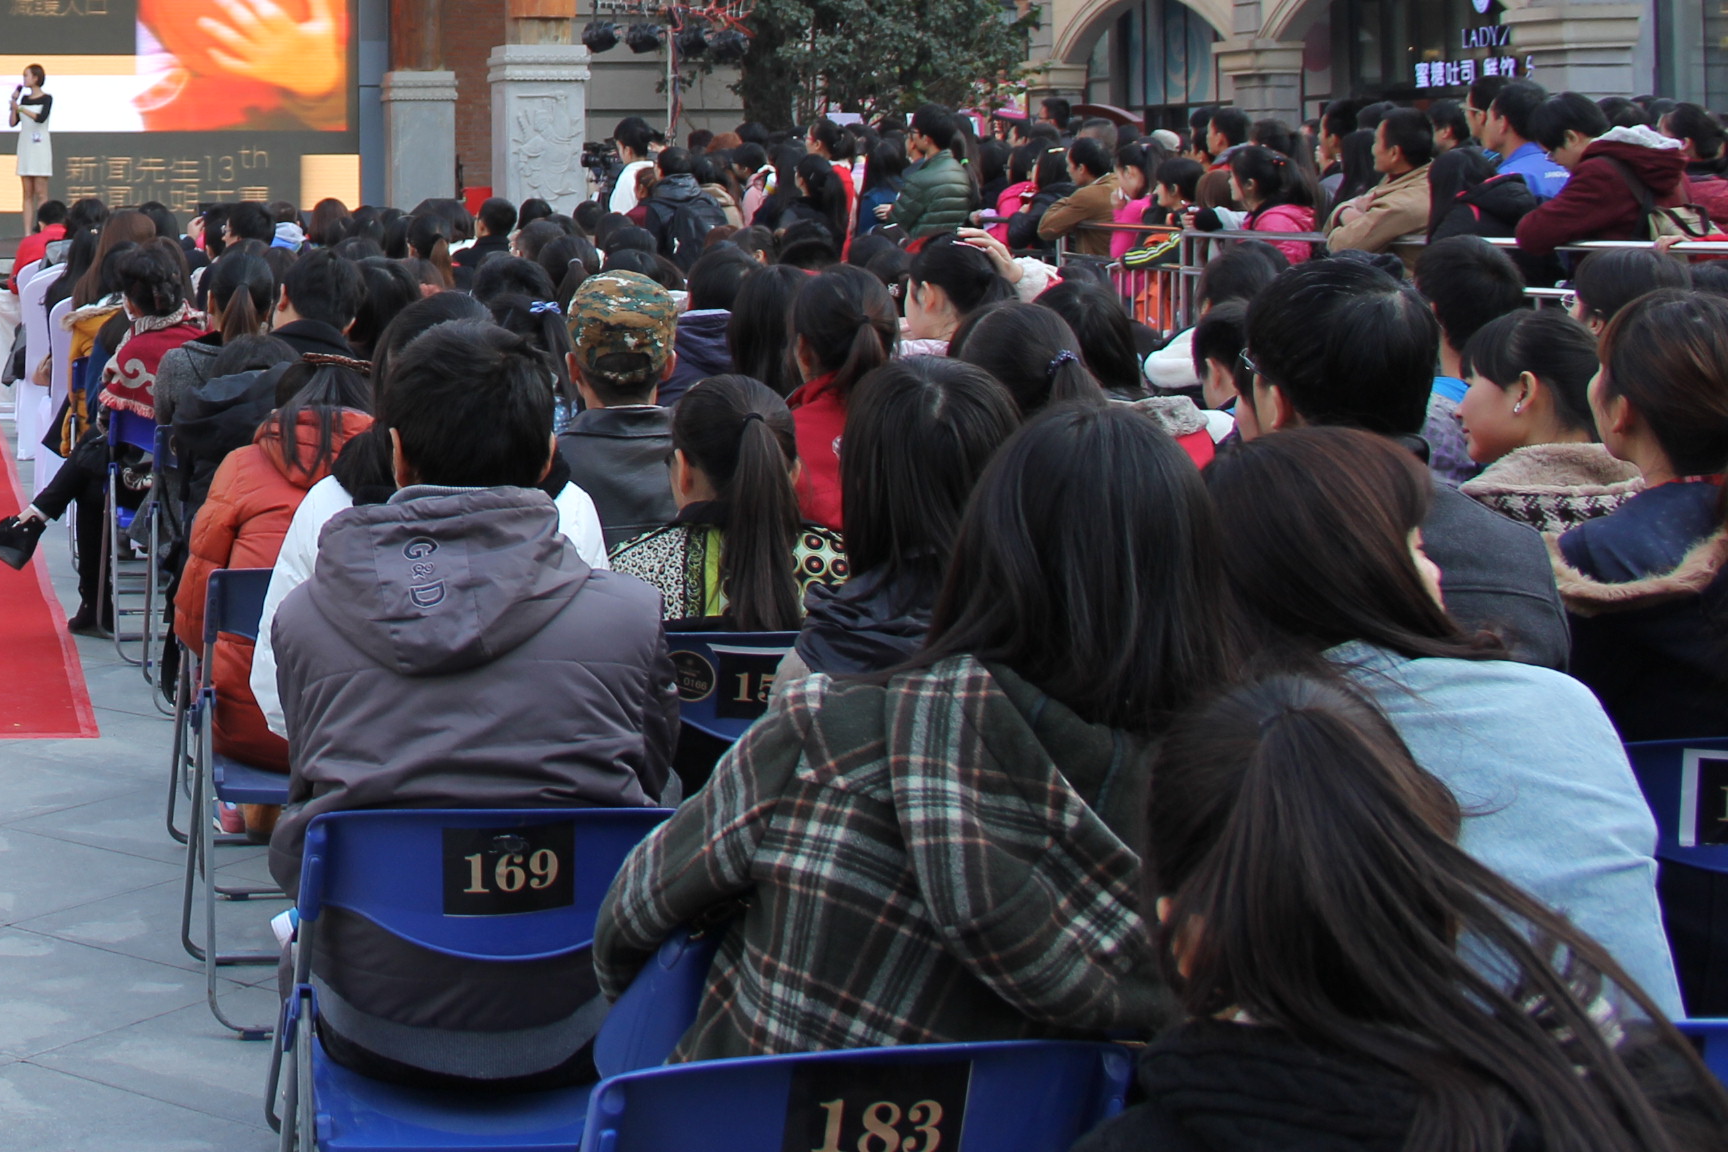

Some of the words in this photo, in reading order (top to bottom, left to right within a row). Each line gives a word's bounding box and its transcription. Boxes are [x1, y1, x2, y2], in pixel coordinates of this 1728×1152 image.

[733, 672, 776, 703] 15
[463, 849, 559, 893] 169
[810, 1098, 944, 1152] 183
